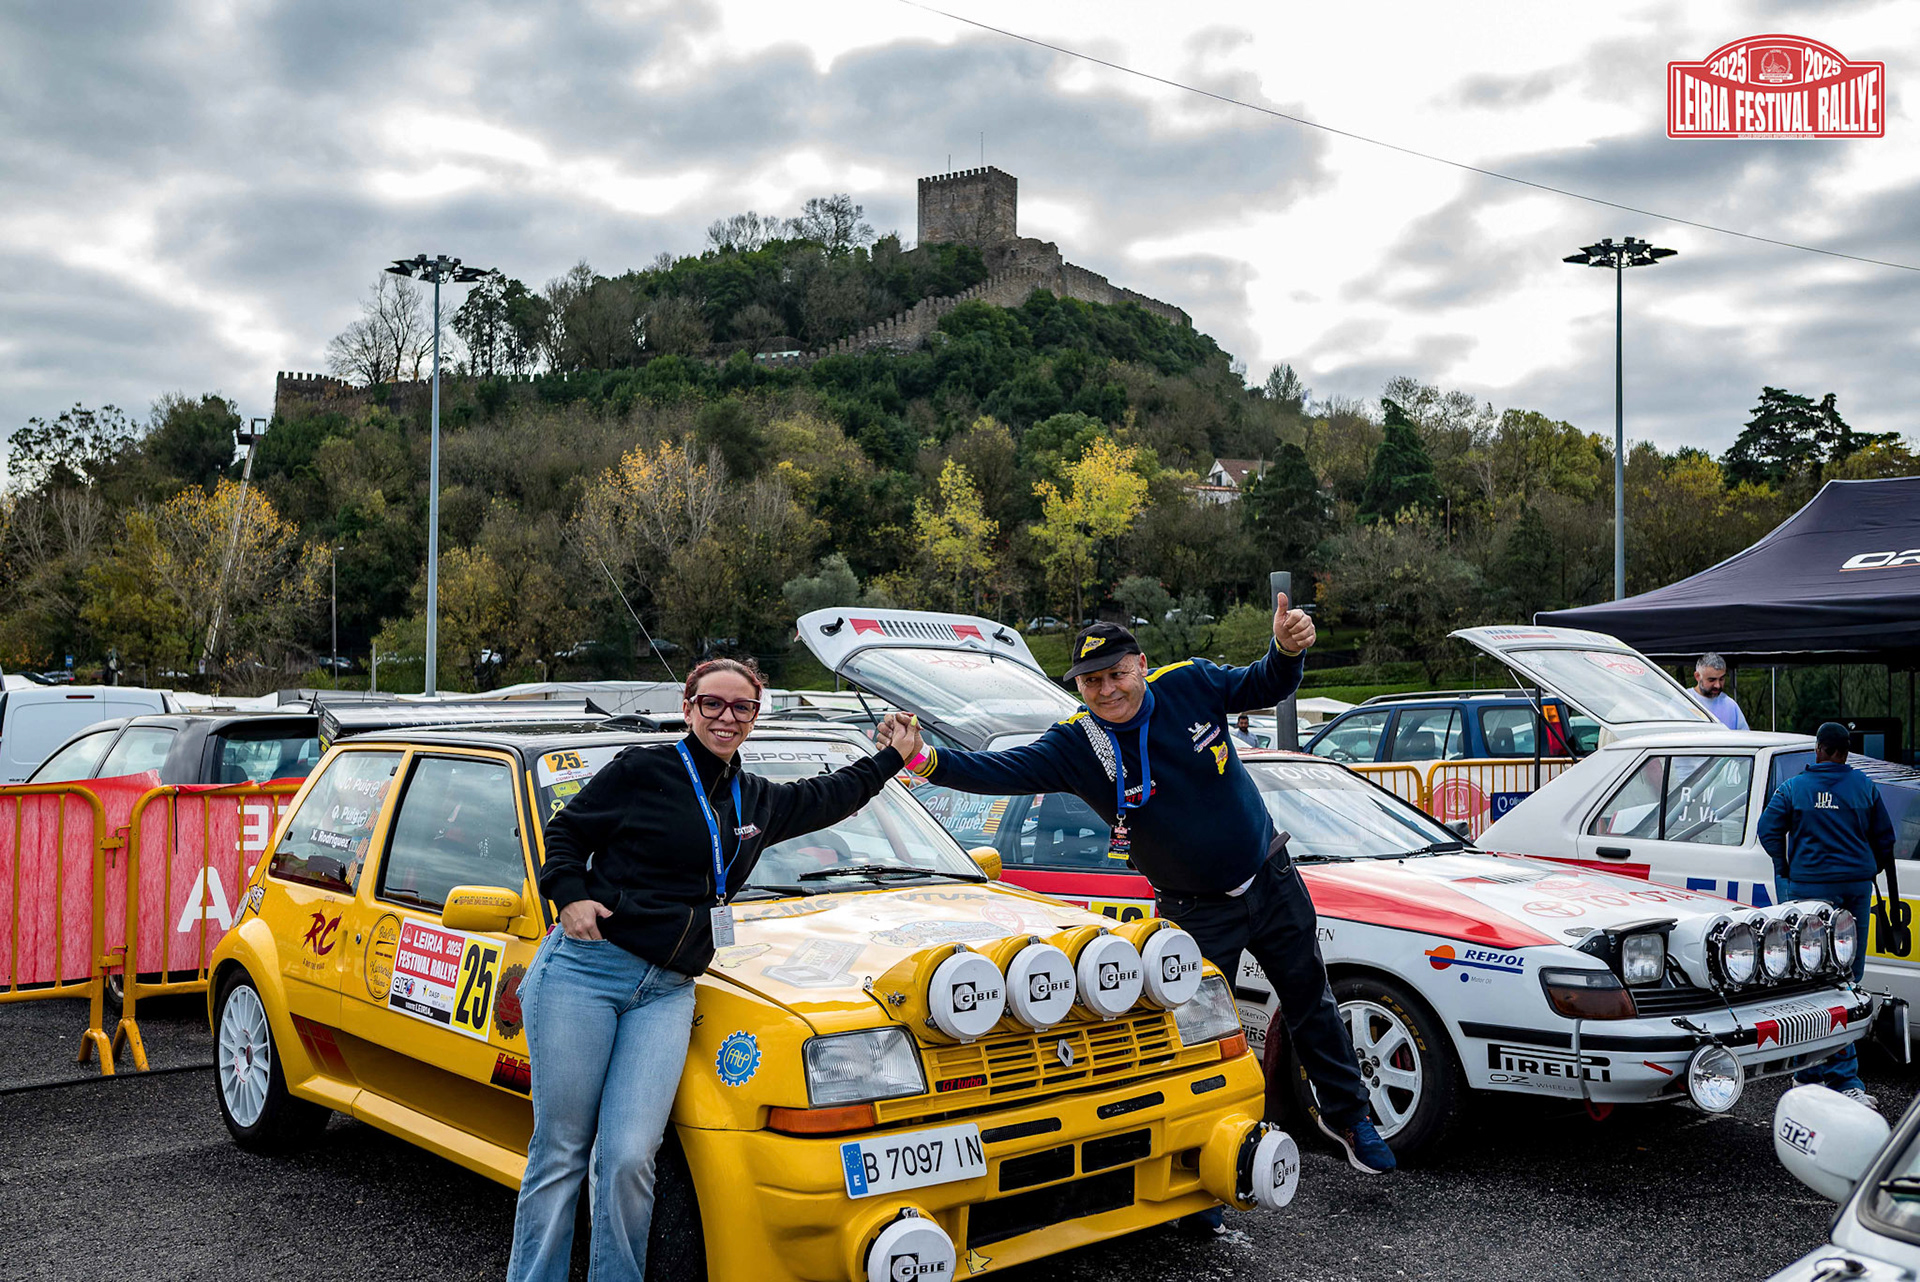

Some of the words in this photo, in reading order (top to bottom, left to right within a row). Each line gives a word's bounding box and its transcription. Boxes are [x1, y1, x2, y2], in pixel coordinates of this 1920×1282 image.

[551, 752, 581, 772] 25
[743, 752, 828, 762] SPORT
[352, 778, 372, 795] Puig
[1680, 786, 1696, 803] R.
[935, 796, 949, 812] M.
[952, 798, 993, 813] Romeu
[1678, 805, 1692, 821] J.
[340, 806, 358, 826] Puig
[301, 909, 343, 962] RC
[413, 930, 443, 954] LEIRIA
[446, 940, 462, 957] 2025
[398, 950, 430, 974] FESTIVAL
[430, 957, 458, 983] RALLYE
[1464, 949, 1525, 967] REPSOL
[455, 944, 498, 1030] 25
[1487, 1043, 1611, 1083] PIRELLI
[943, 1079, 956, 1091] GT
[957, 1076, 983, 1090] turbo
[1536, 1083, 1575, 1092] WHEELS
[1780, 1117, 1816, 1149] GT2i
[863, 1152, 880, 1183] B
[886, 1141, 943, 1180] 7097
[954, 1134, 984, 1168] IN
[853, 1174, 861, 1187] E
